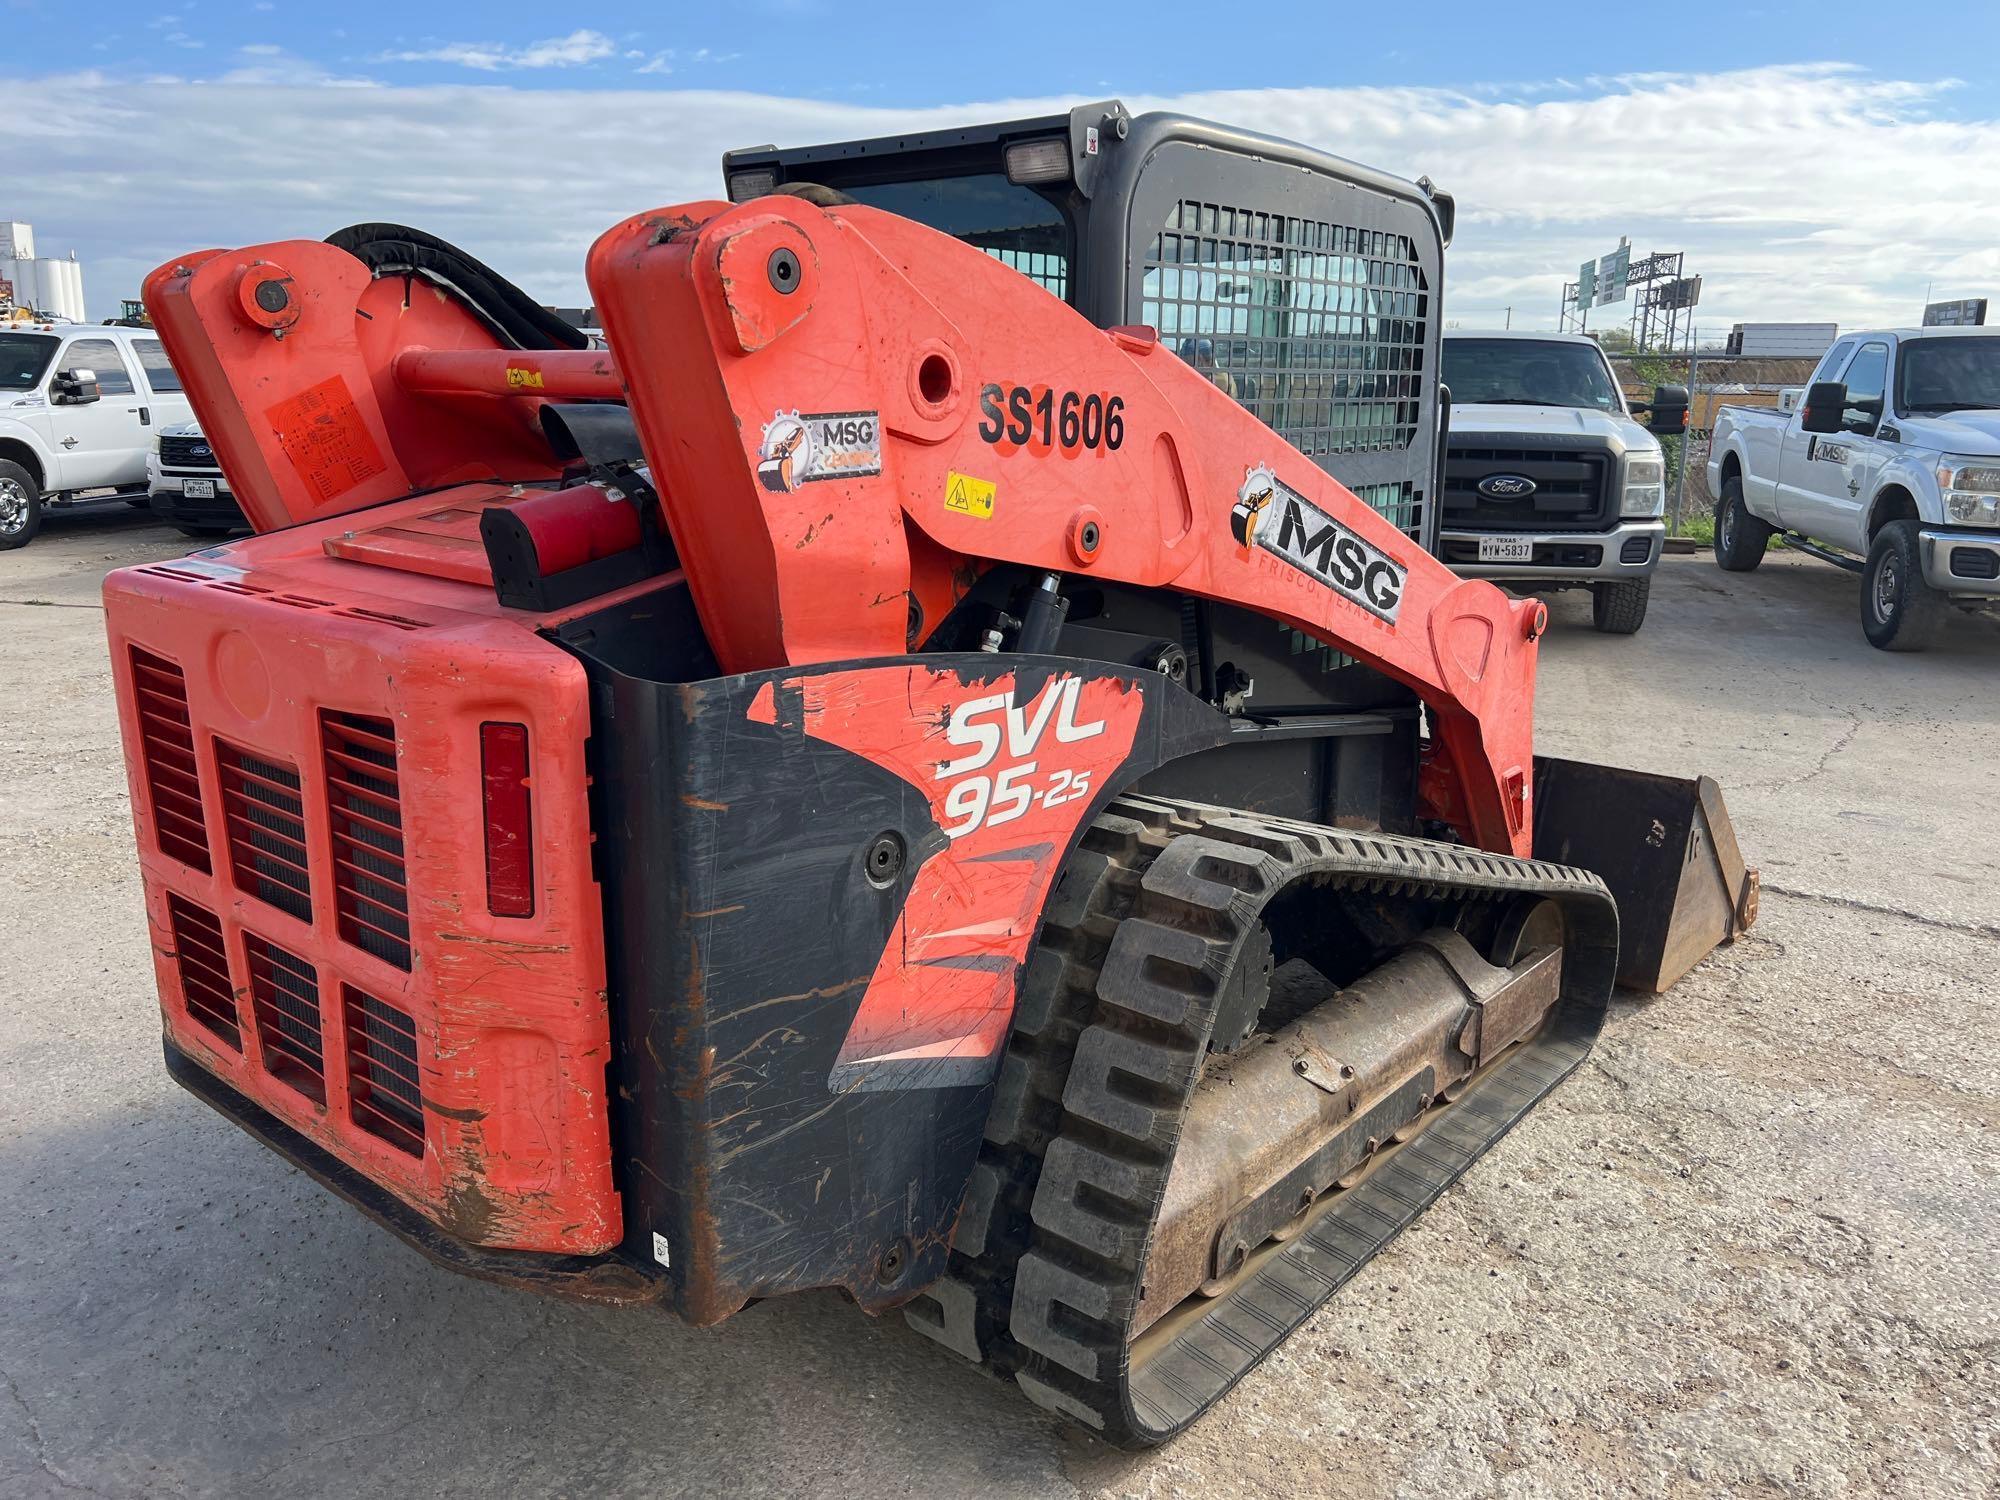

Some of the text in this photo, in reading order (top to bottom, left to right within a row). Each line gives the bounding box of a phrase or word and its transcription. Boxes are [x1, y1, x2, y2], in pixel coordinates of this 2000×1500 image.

[823, 420, 873, 447] MSG
[978, 383, 1125, 451] SS1606
[1491, 479, 1522, 493] Ford
[1276, 498, 1401, 610] MSG
[935, 676, 1106, 780] SVL
